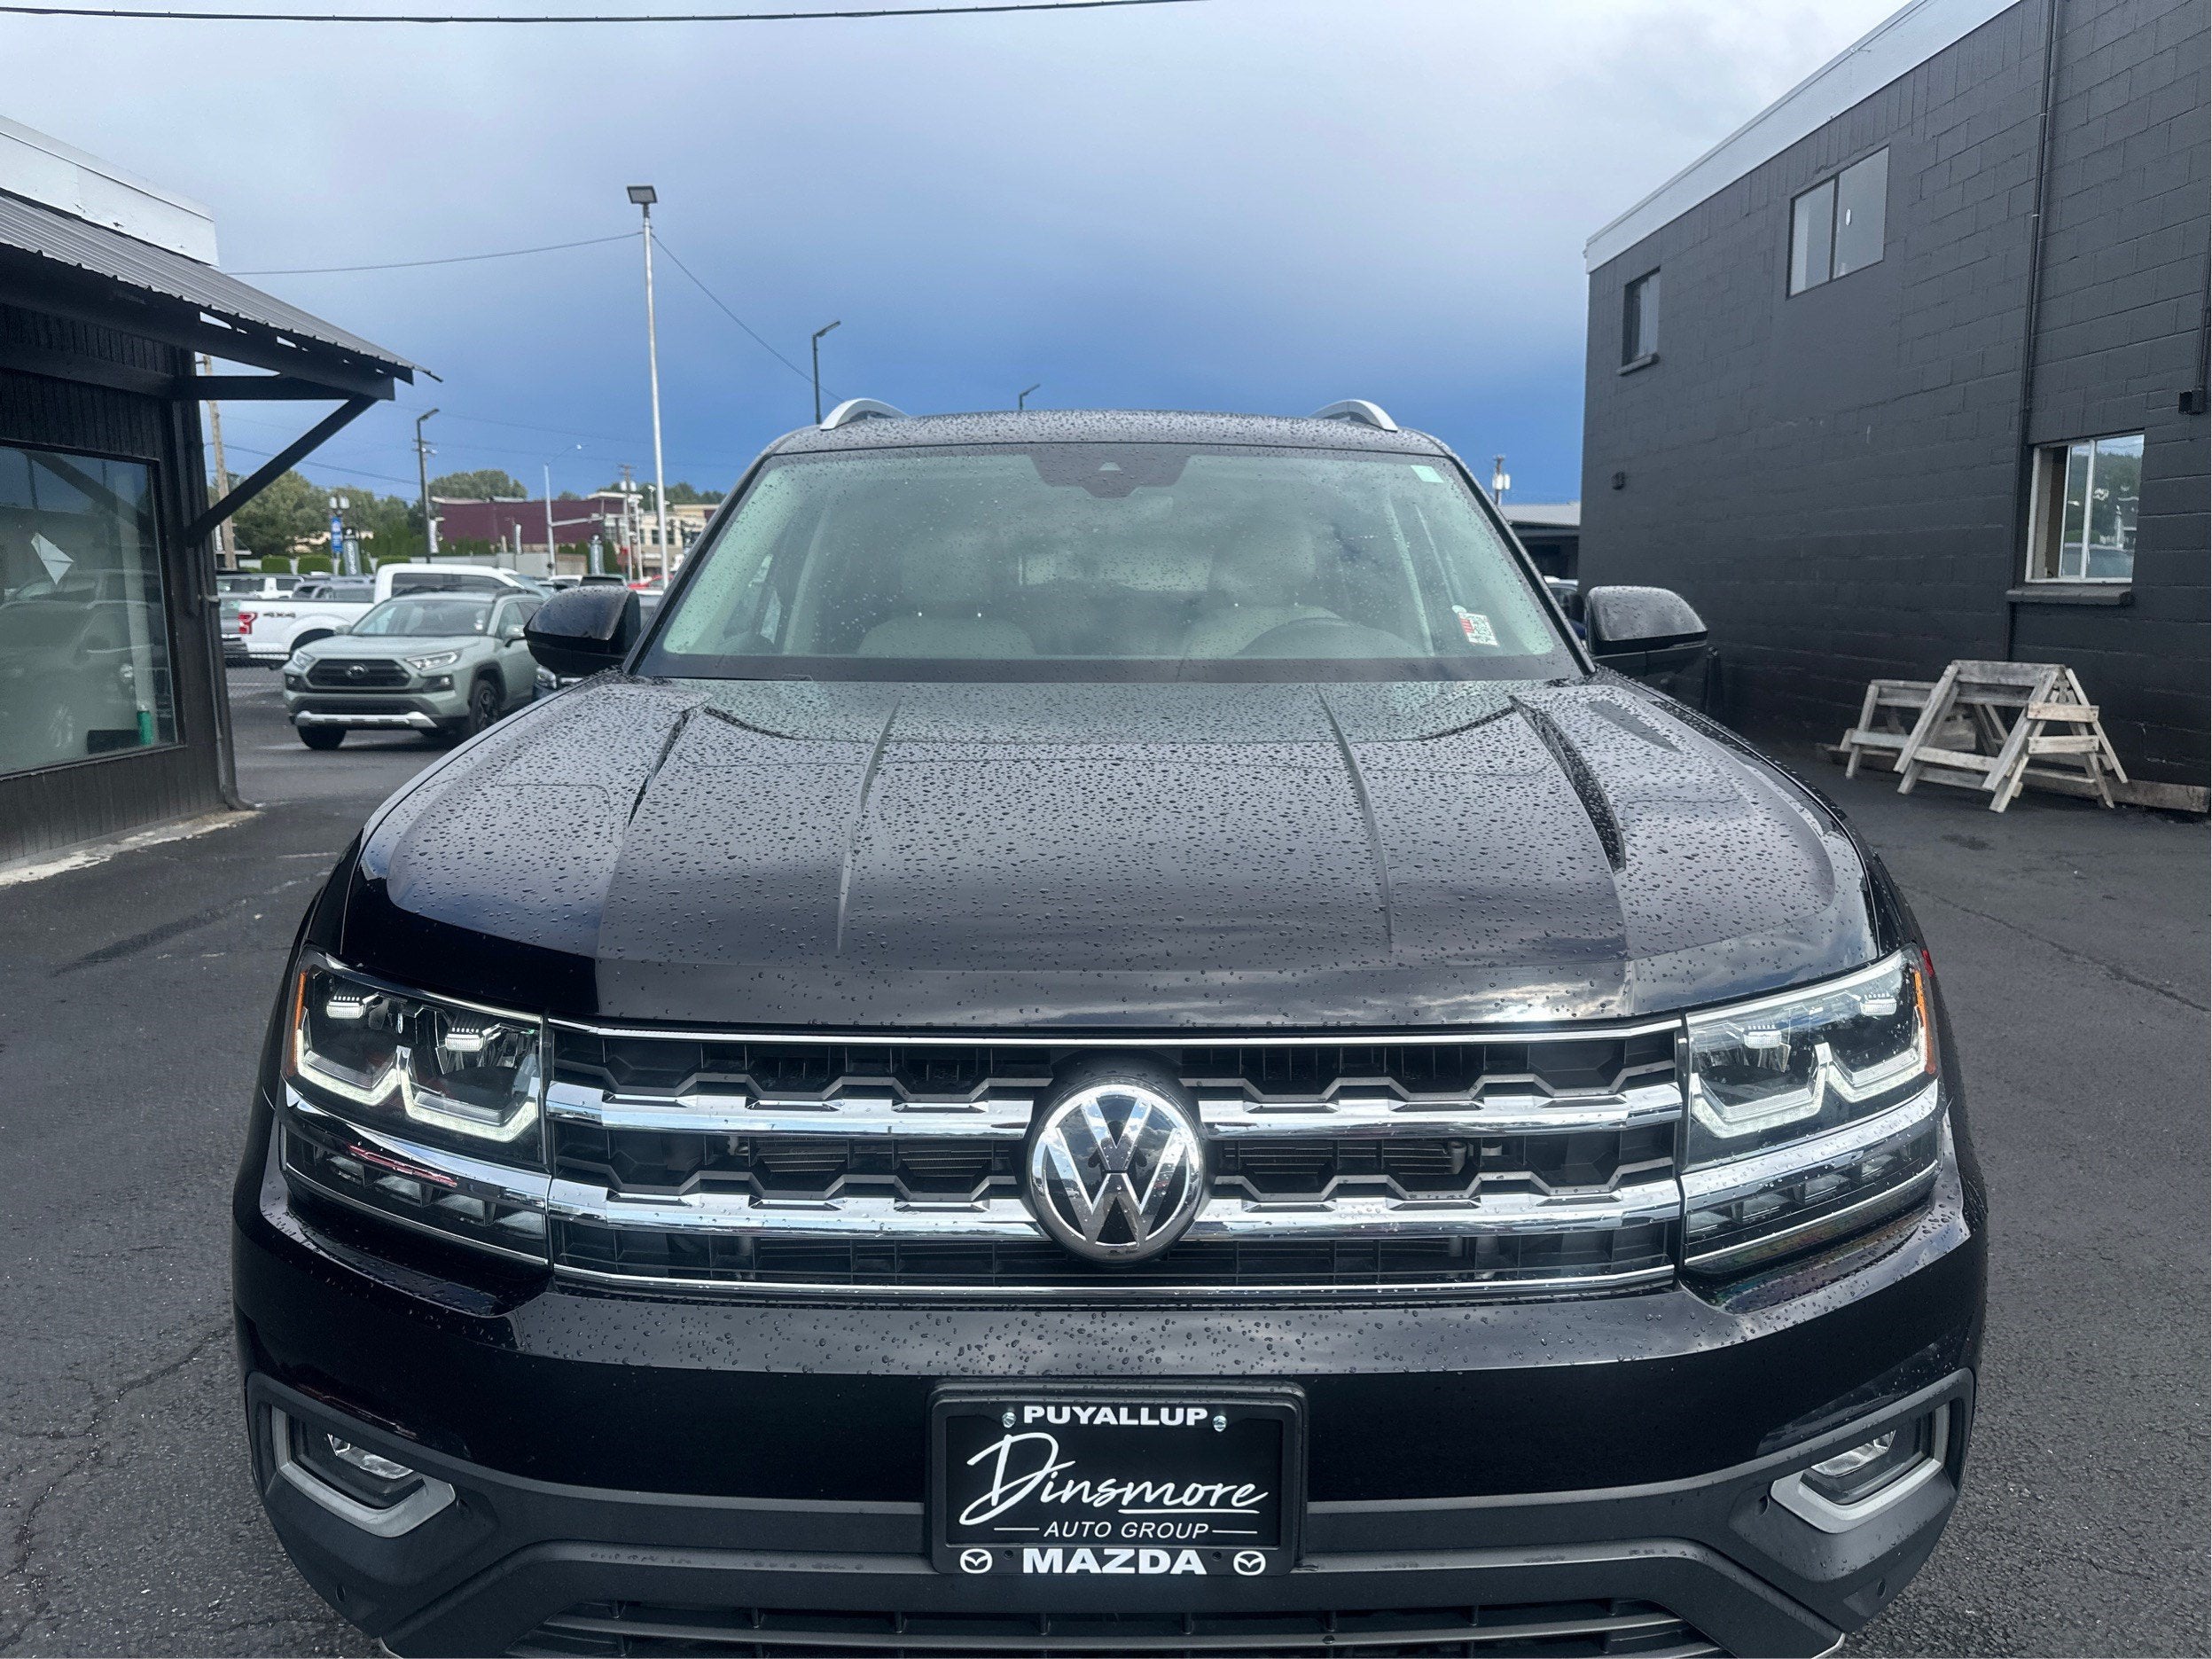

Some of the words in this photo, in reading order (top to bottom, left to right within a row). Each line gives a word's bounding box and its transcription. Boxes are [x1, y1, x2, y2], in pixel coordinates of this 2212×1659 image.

[1023, 1405, 1208, 1426] PUYALLUP
[958, 1431, 1269, 1525] Dinsmore
[1043, 1522, 1112, 1538] AUTO
[1121, 1522, 1209, 1539] GROUP
[1022, 1547, 1208, 1575] MAZDA
